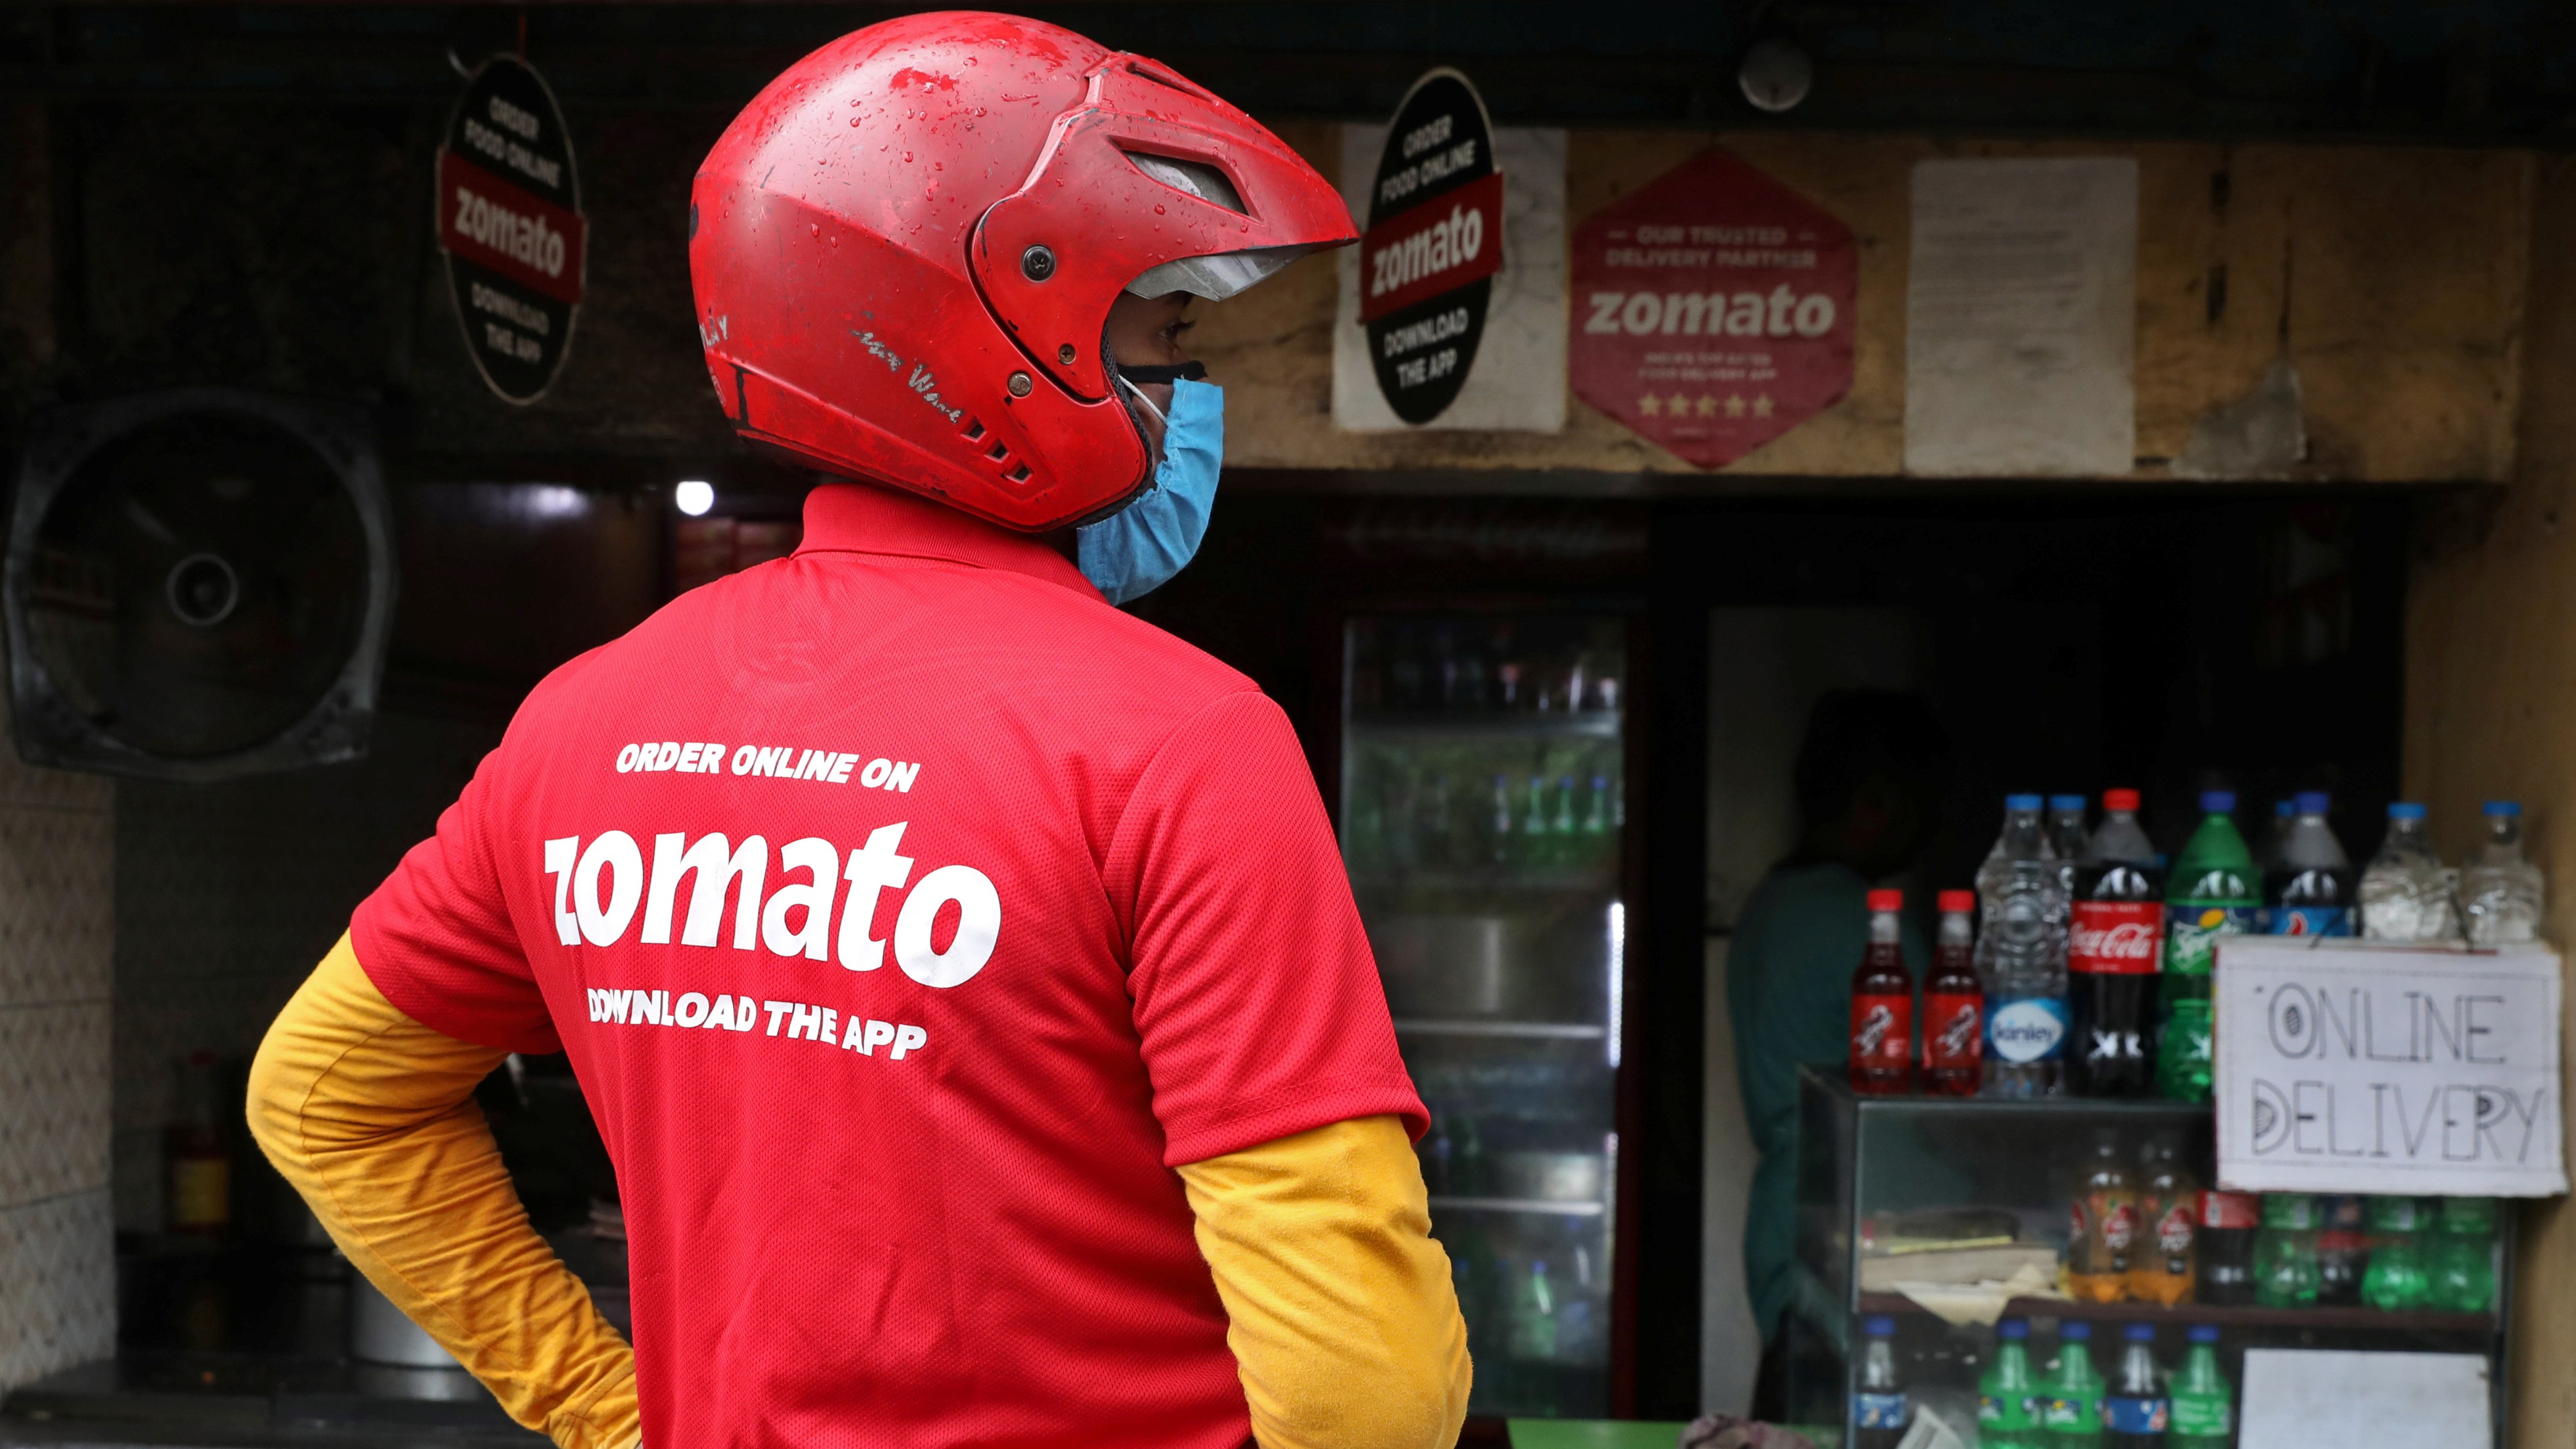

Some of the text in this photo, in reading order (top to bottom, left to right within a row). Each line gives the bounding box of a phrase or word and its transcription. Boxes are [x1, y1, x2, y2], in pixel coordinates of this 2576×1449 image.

[490, 96, 539, 140] ORDER
[1403, 114, 1453, 159] ORDER
[465, 118, 561, 188] FOOD ONLINE
[1382, 139, 1476, 201] FOOD ONLINE
[455, 188, 565, 278] zomato
[1371, 201, 1482, 297] zomato
[472, 282, 549, 336] DOWNLOAD
[1384, 307, 1468, 357] DOWNLOAD
[1584, 282, 1836, 337] zomato
[486, 322, 542, 363] THE APP
[1396, 347, 1457, 388] THE APP
[616, 742, 921, 793] ORDER ONLINE ON
[544, 821, 1001, 988] zomato
[587, 987, 928, 1060] DOWNLOAD THE APP
[2268, 982, 2506, 1064] ONLINE
[2251, 1079, 2545, 1163] DELIVERY
